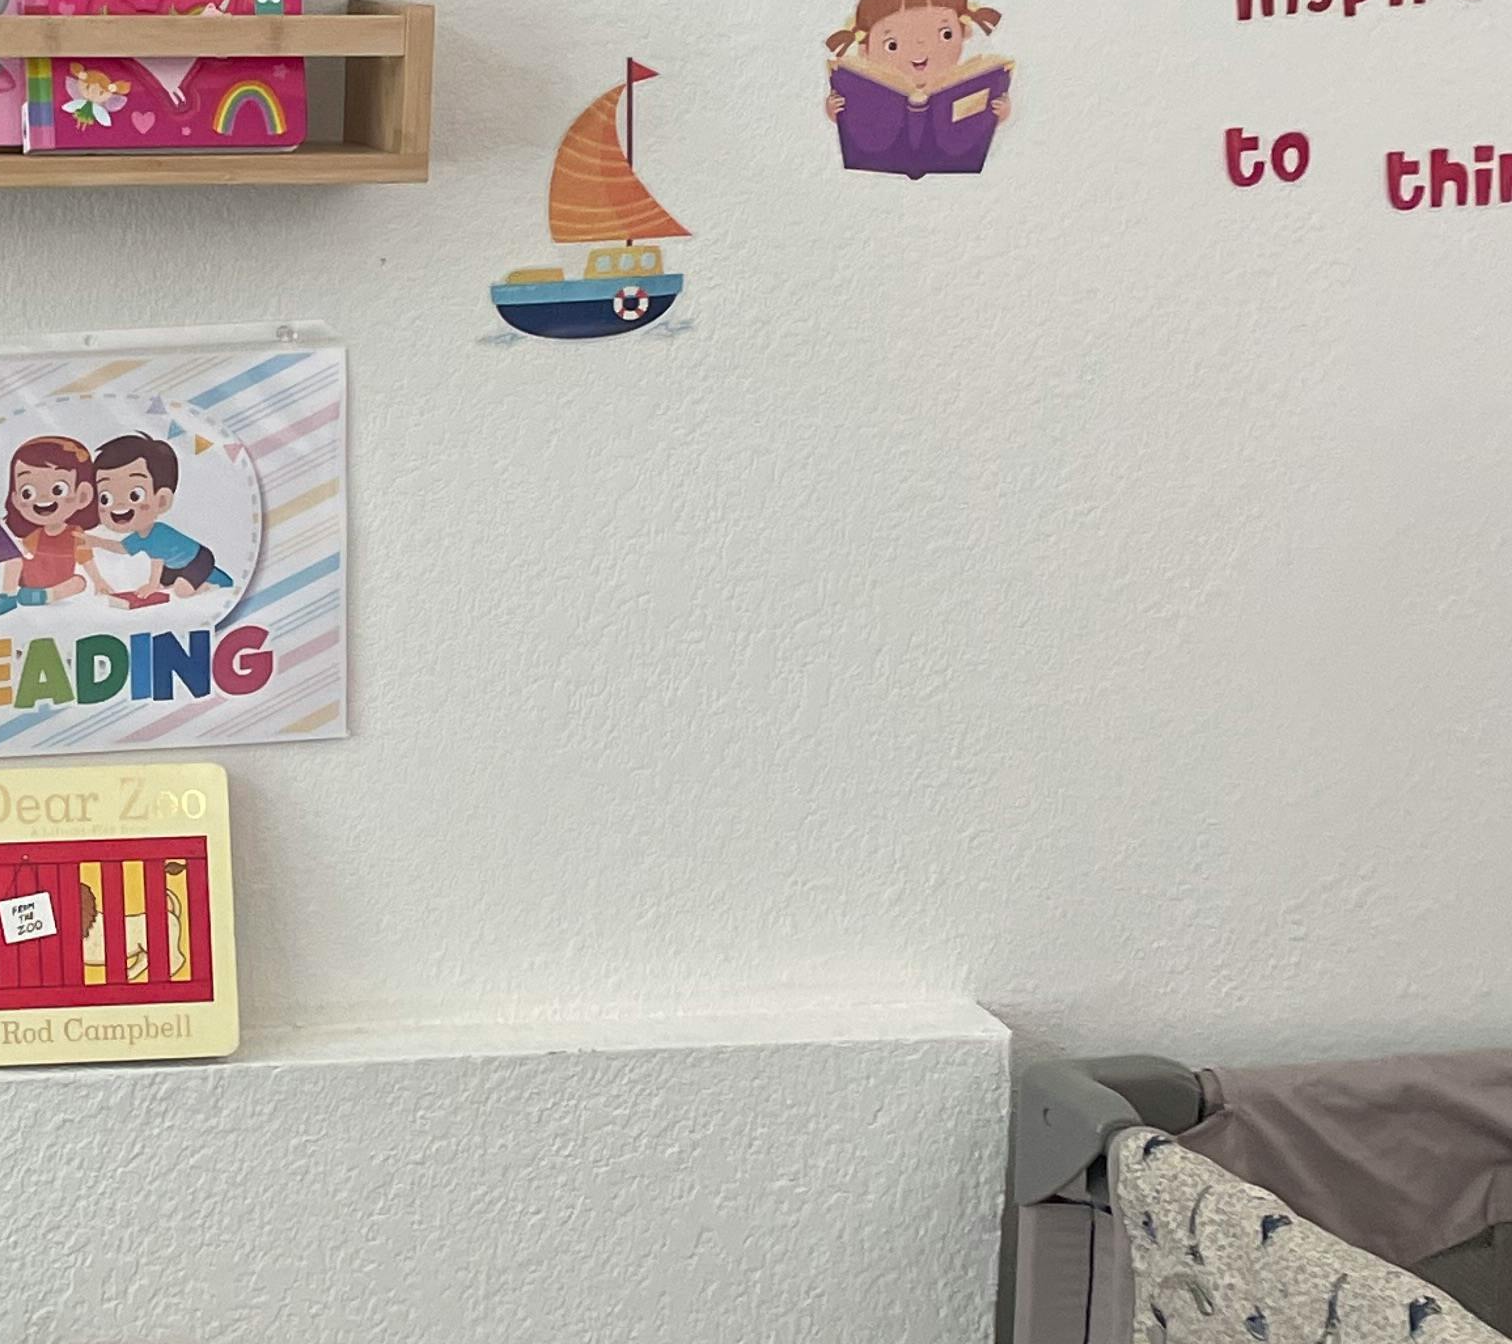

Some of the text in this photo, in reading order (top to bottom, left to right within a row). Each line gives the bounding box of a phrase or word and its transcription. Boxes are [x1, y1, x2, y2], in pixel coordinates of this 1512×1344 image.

[1224, 127, 1311, 187] to
[119, 777, 207, 820] Zoo
[17, 920, 43, 936] ZOO
[2, 1014, 193, 1045] Rod Campbell
